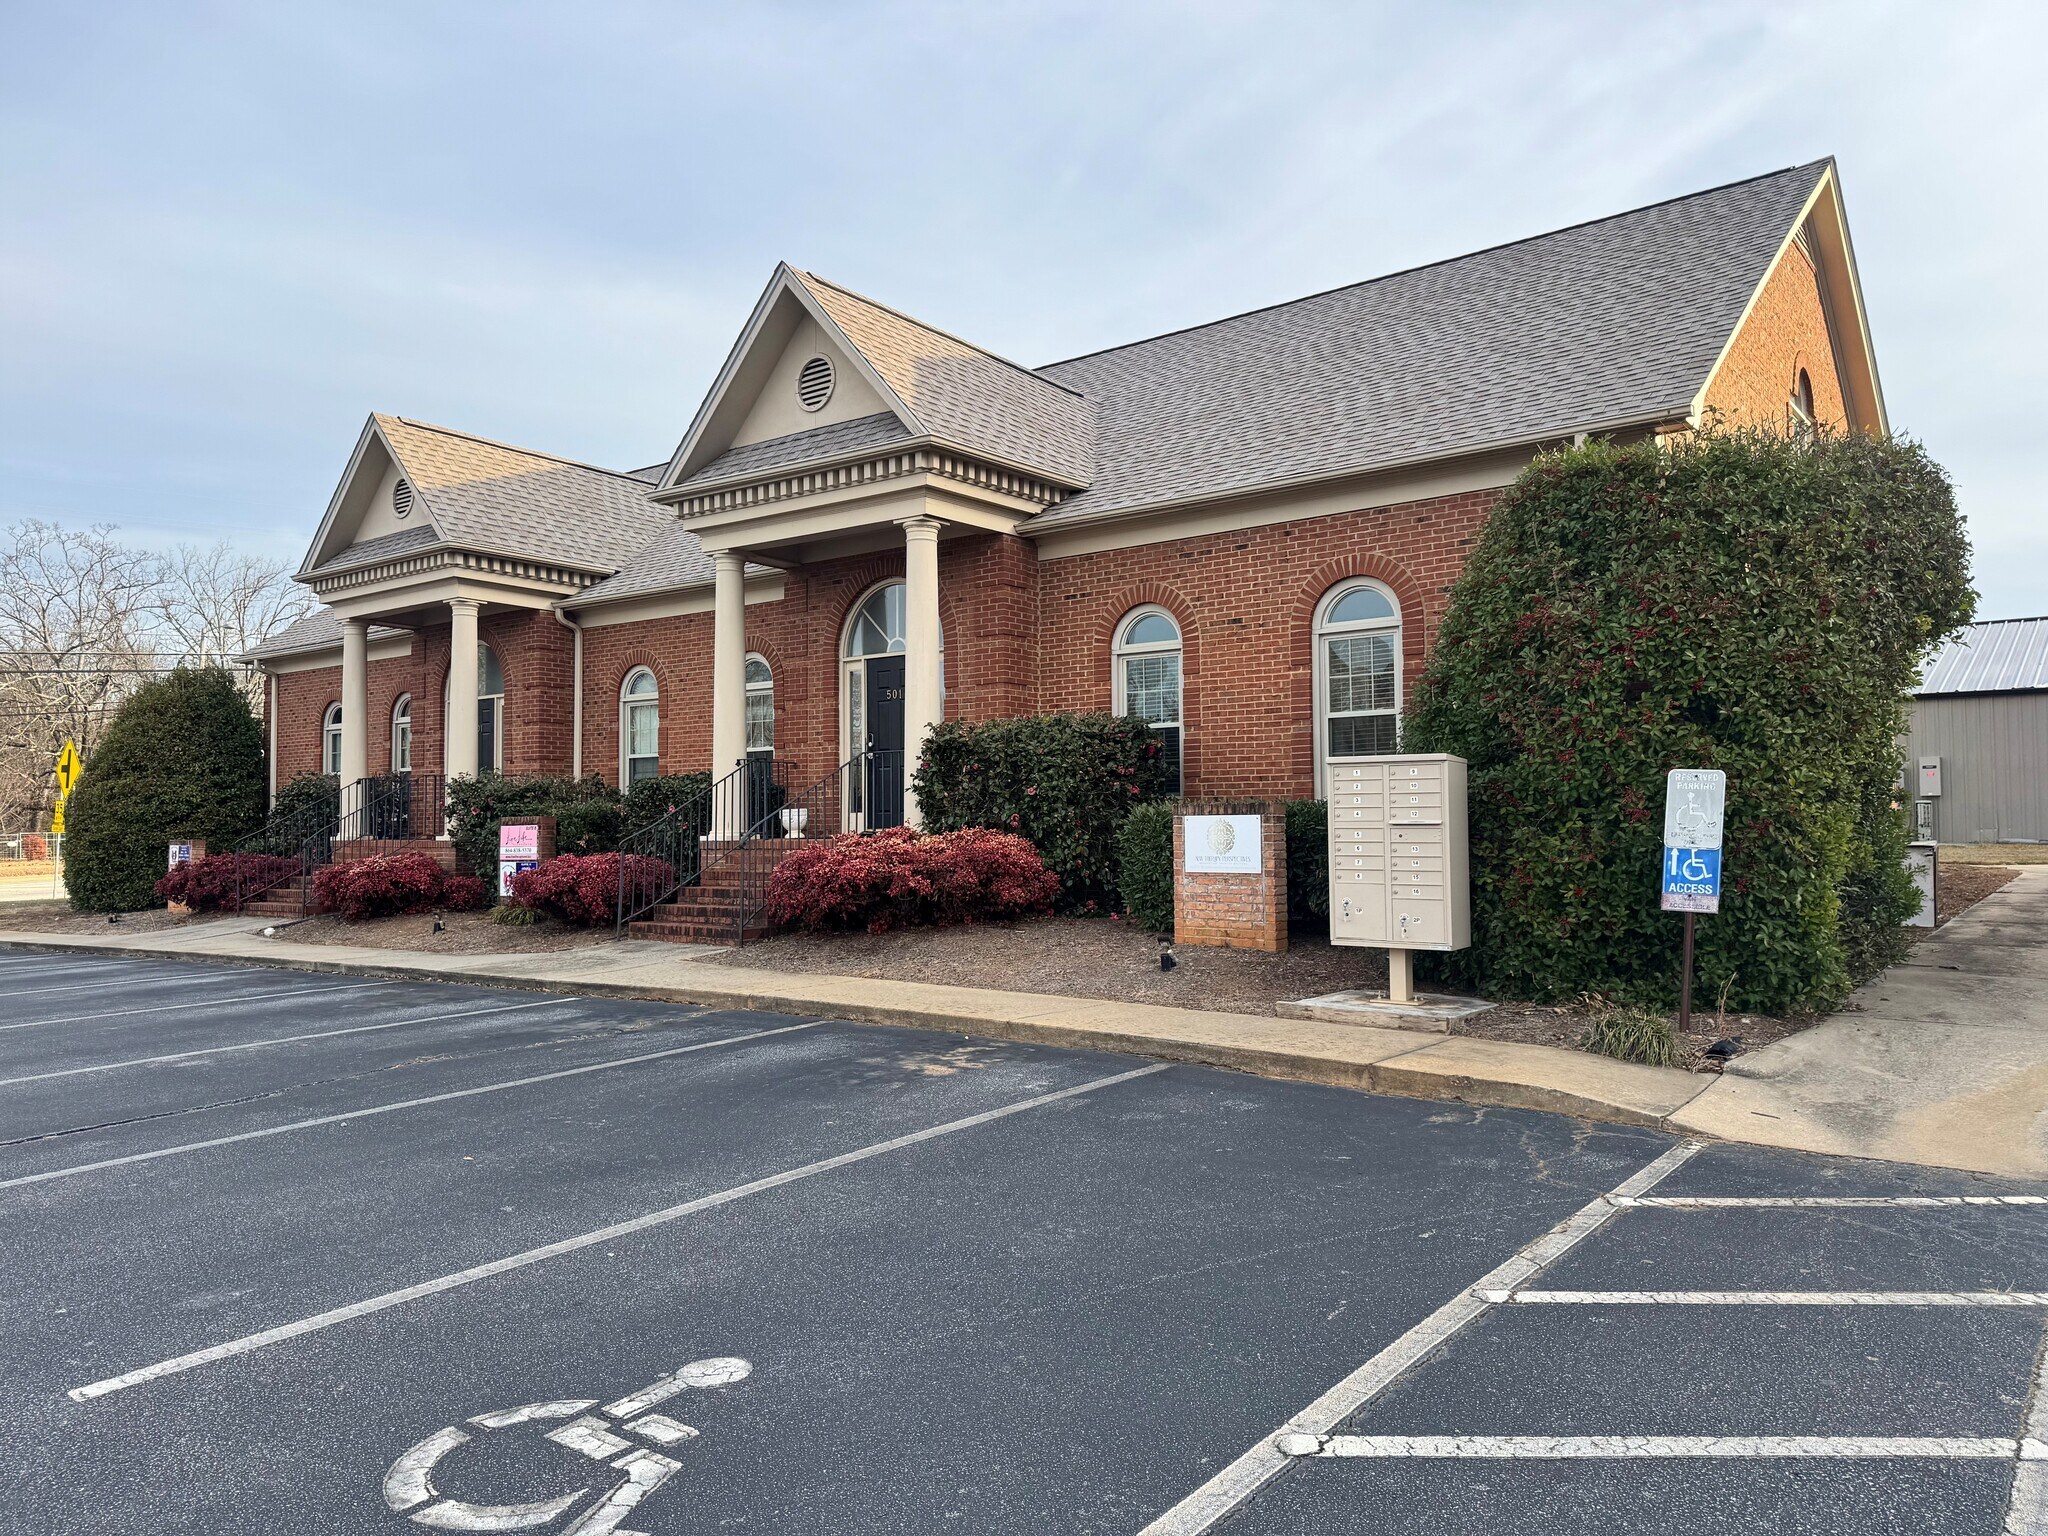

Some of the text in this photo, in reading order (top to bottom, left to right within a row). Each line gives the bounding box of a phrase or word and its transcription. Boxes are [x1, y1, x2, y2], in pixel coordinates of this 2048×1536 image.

[1675, 772, 1719, 782] RESERVED
[1676, 782, 1716, 790] PARKING
[1668, 882, 1713, 895] ACCESS
